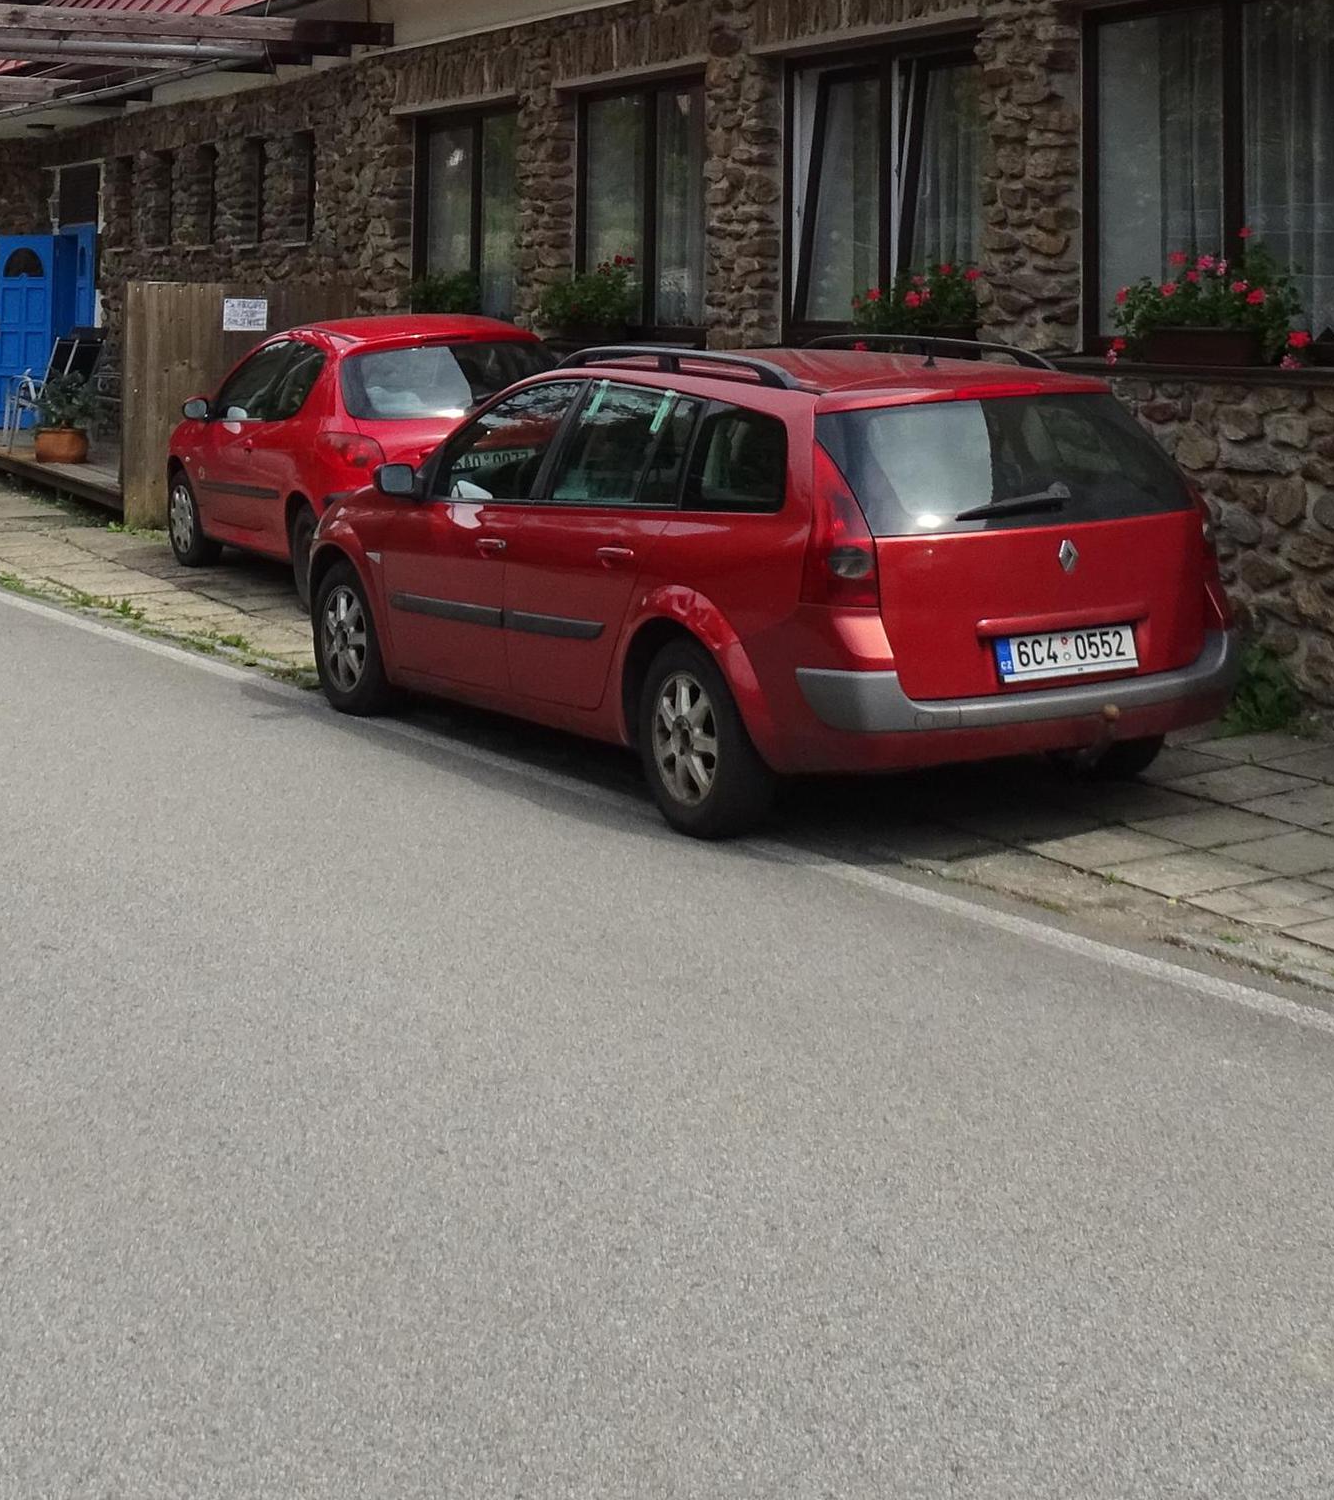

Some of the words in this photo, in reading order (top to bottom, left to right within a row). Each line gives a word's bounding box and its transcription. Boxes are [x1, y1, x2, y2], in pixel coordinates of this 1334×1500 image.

[1017, 637, 1058, 667] 6C4
[1075, 630, 1126, 660] 0552
[1000, 661, 1013, 670] CZ
